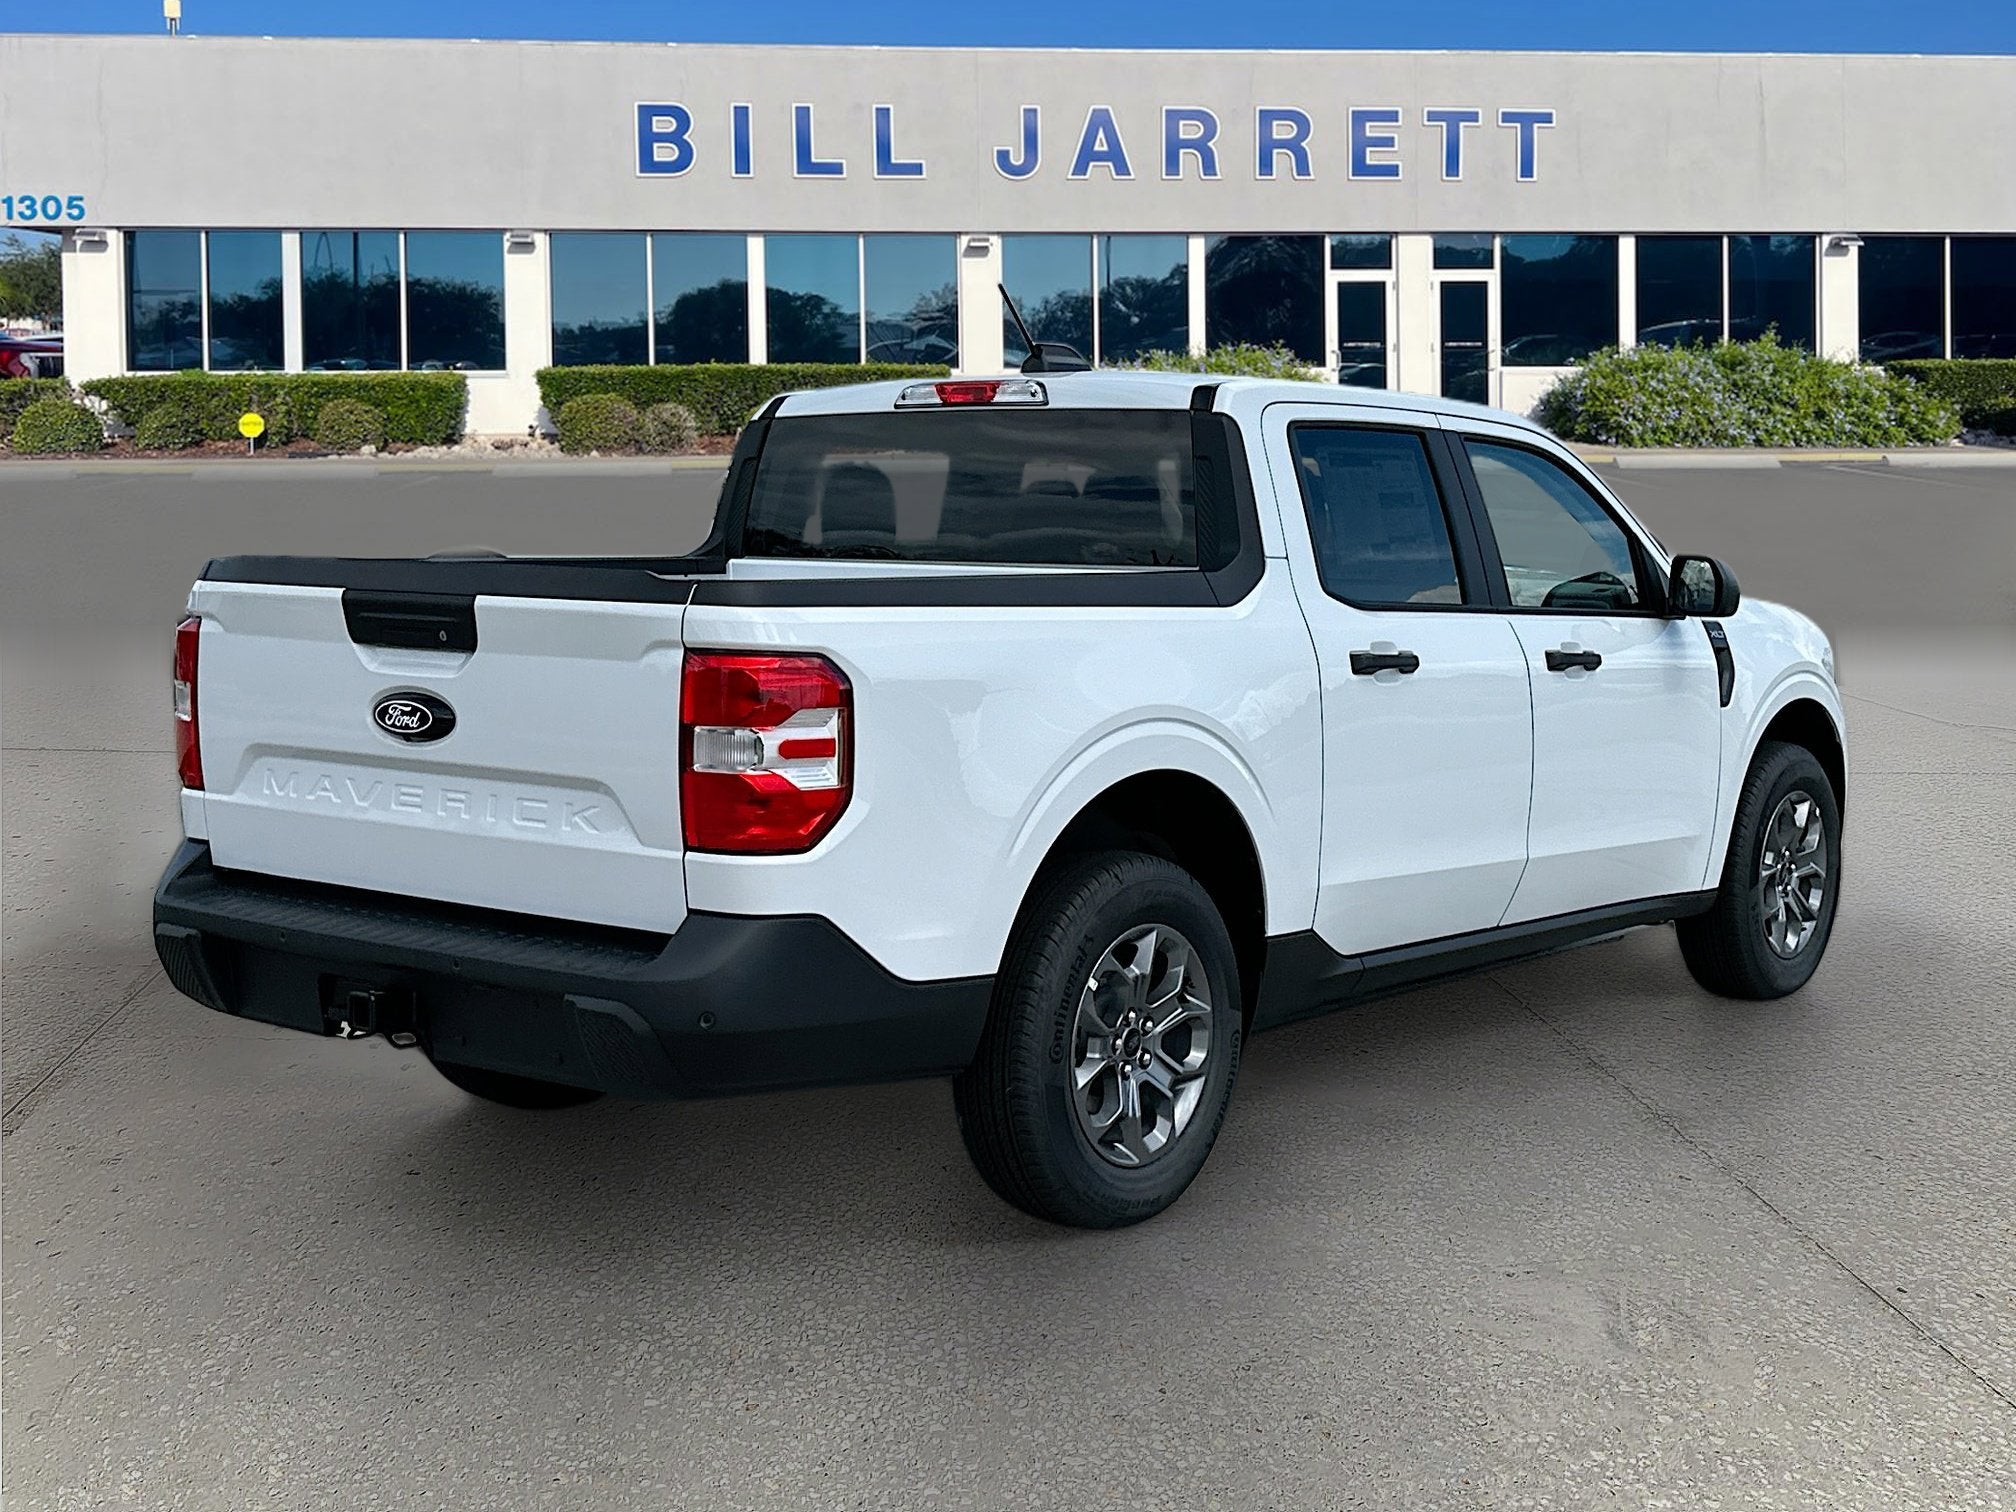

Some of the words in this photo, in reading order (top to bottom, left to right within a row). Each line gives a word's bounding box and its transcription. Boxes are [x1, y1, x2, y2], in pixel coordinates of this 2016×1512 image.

[634, 101, 926, 179] BILL
[993, 104, 1556, 182] JARRETT
[1, 194, 86, 221] 1305
[385, 704, 421, 728] Ford
[262, 768, 601, 835] MAVERICK
